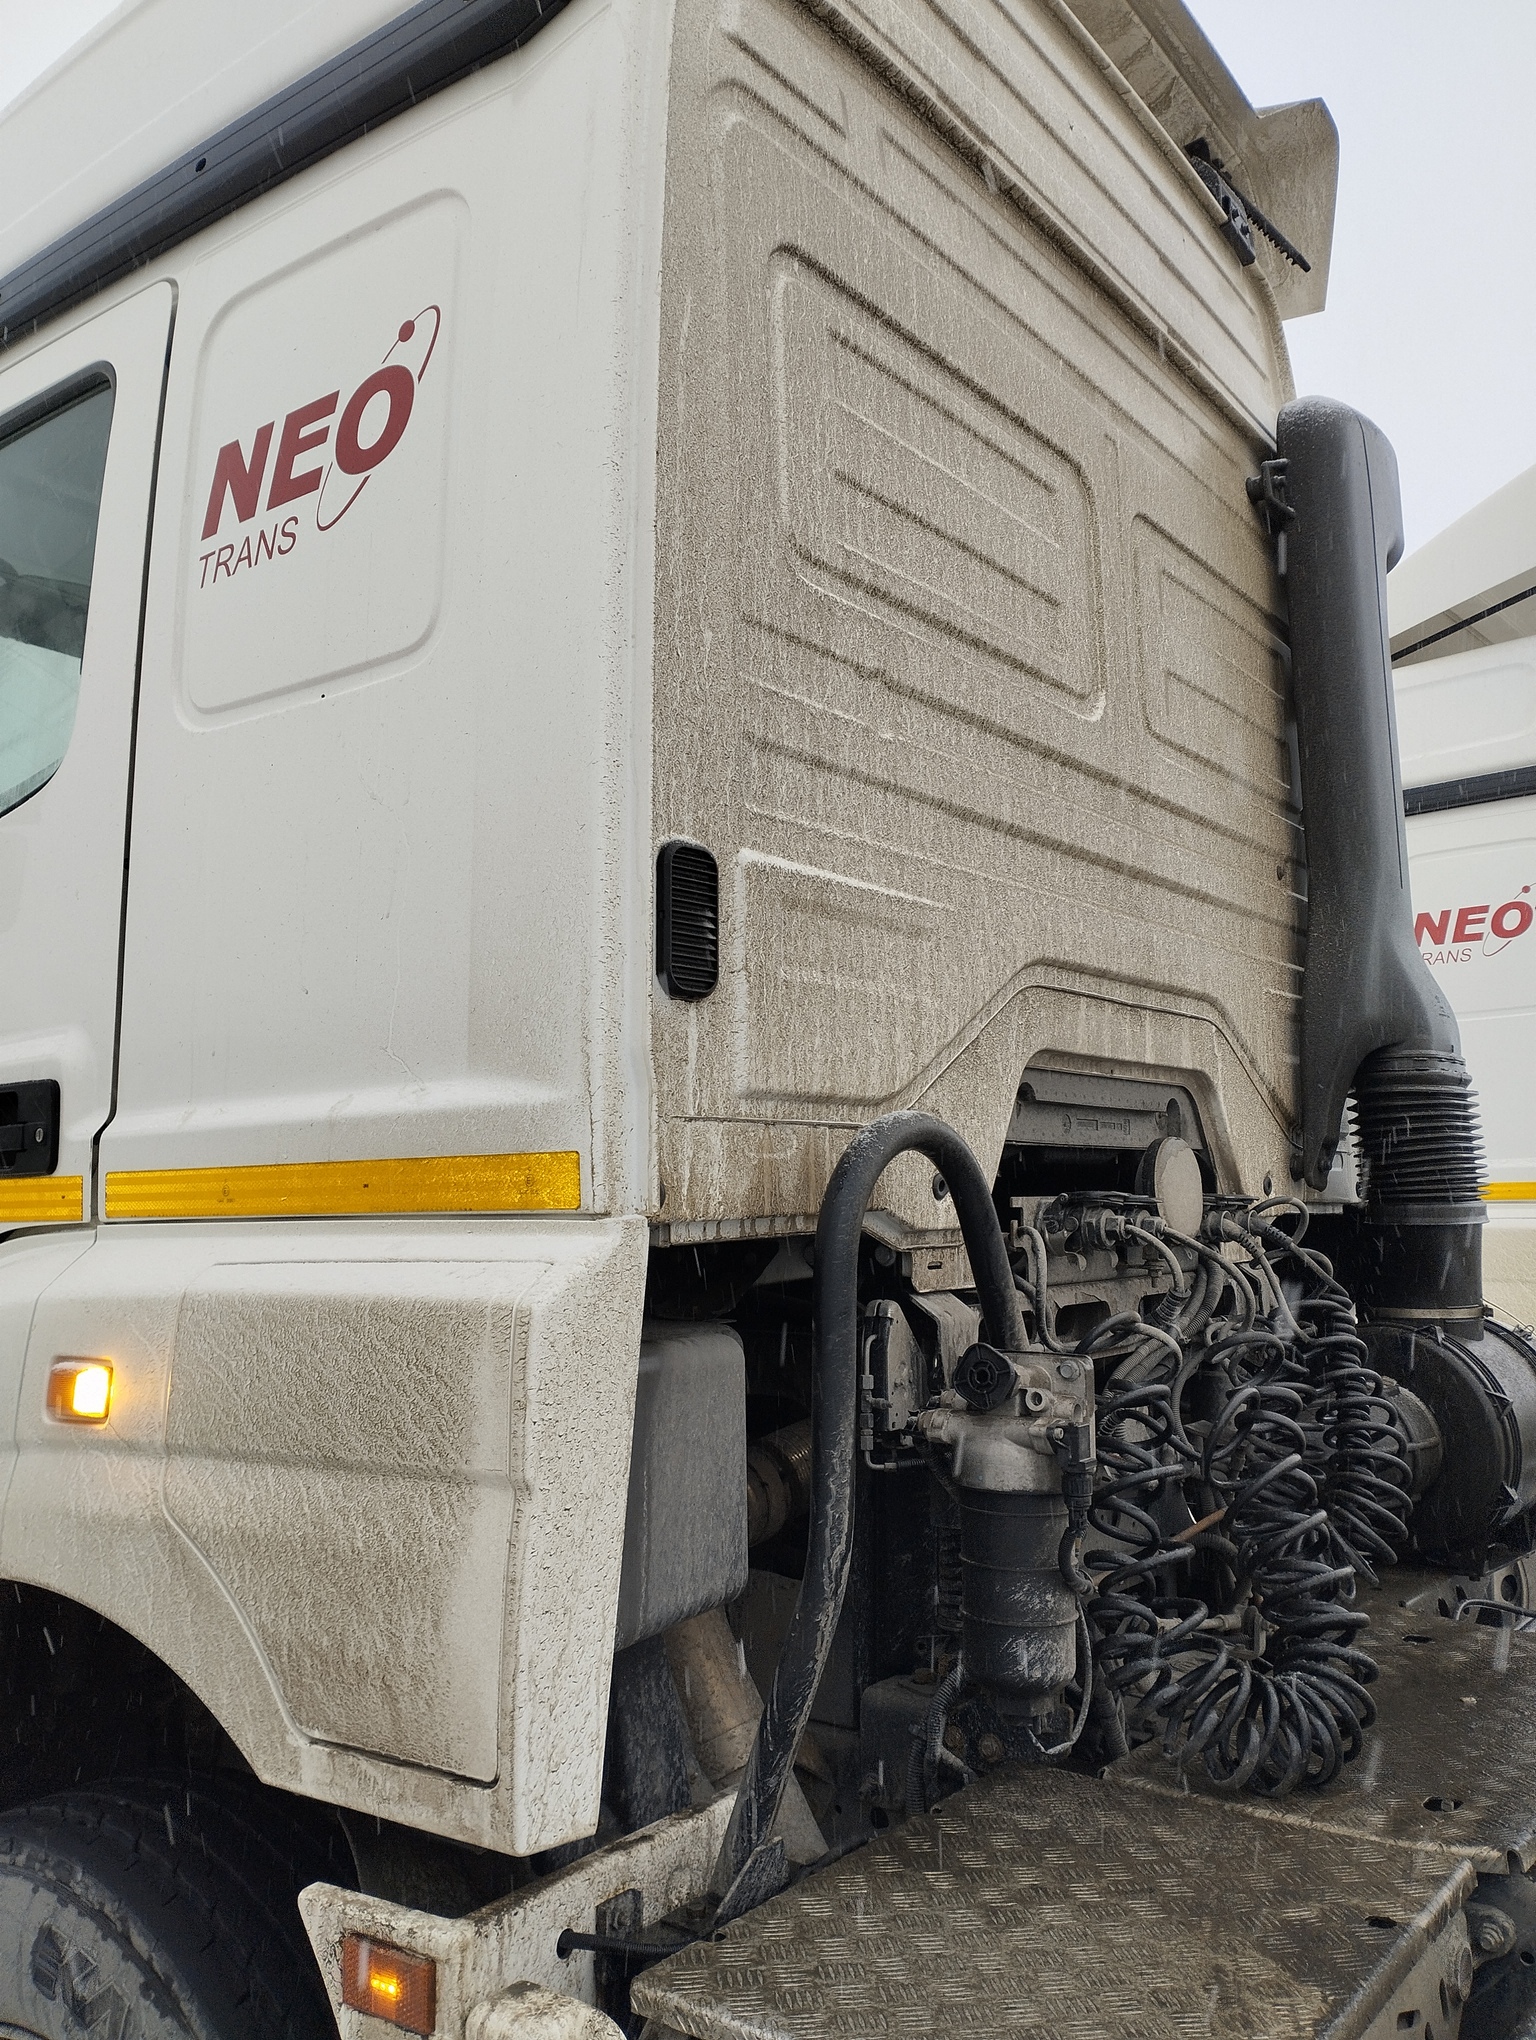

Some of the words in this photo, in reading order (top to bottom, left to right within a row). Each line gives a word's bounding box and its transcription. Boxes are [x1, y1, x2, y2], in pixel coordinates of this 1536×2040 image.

[201, 364, 415, 541] NEO
[199, 515, 299, 589] TRANS
[1414, 901, 1533, 947] NEO
[1422, 948, 1472, 965] RANS
